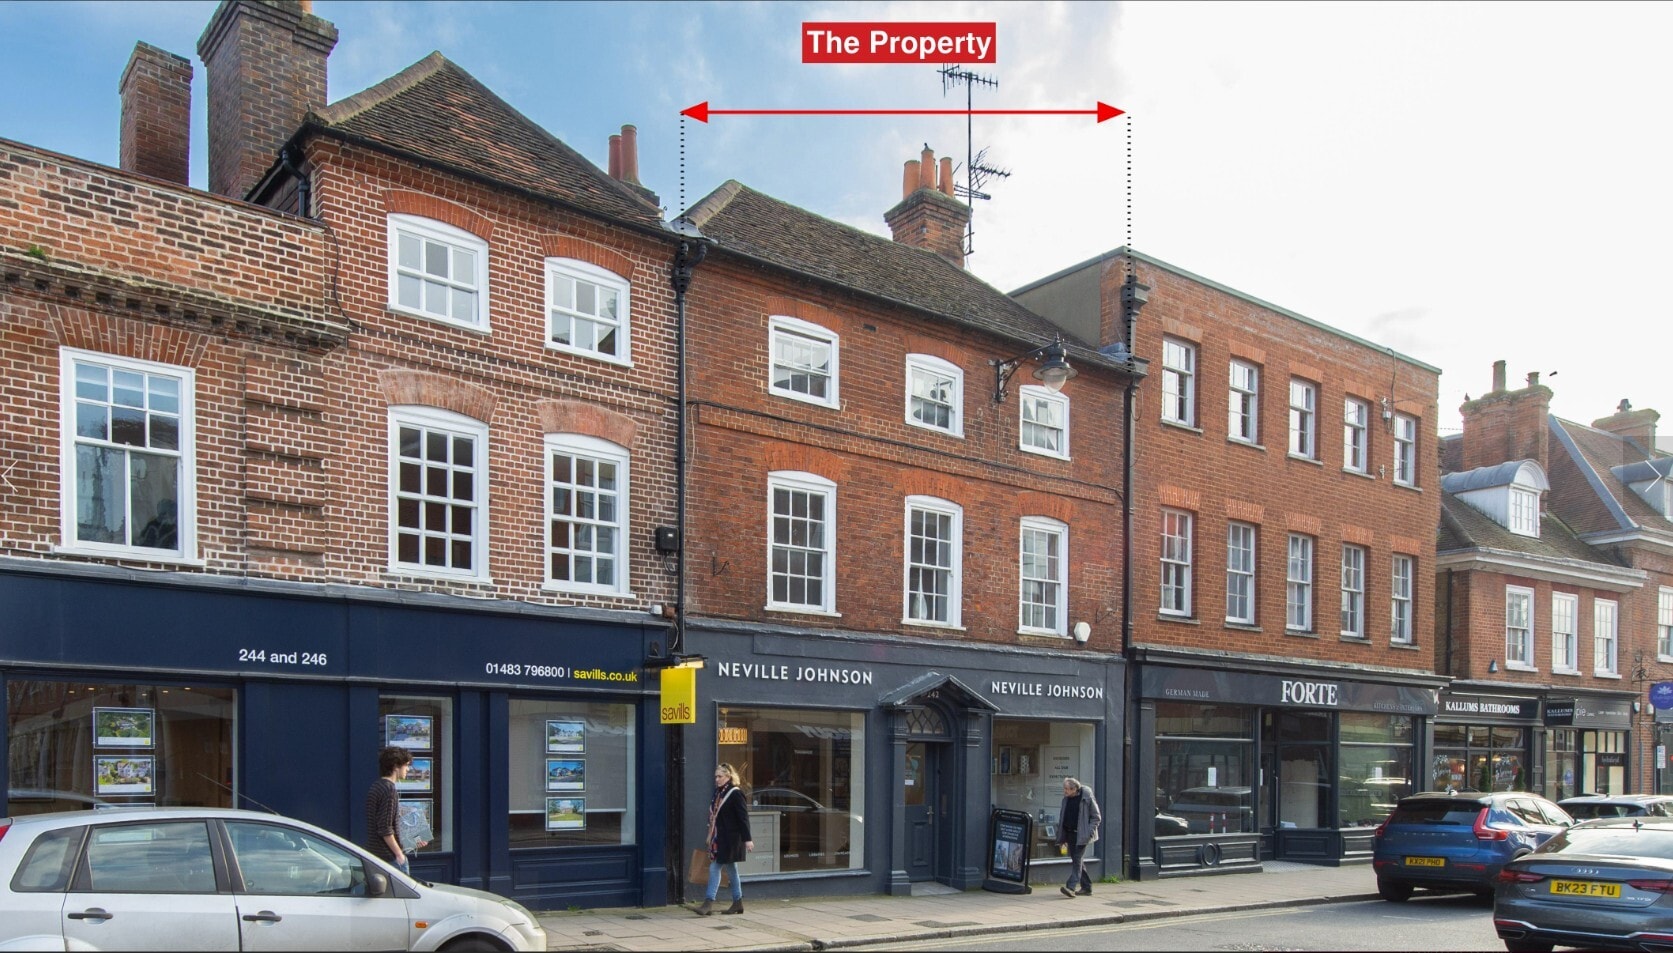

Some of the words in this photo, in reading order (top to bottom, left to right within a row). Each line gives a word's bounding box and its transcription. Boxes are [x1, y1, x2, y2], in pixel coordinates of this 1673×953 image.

[239, 648, 266, 662] 244
[270, 651, 298, 664] and
[301, 652, 327, 666] 246
[485, 662, 521, 676] 01483
[524, 664, 565, 678] 796800
[573, 668, 638, 682] savills.co.uk
[717, 661, 789, 681] NEVILLE
[796, 666, 873, 685] JOHNSON
[991, 681, 1043, 697] NEVILLE
[1047, 684, 1104, 699] JOHNSON
[1165, 688, 1192, 697] GERMAN
[1193, 690, 1210, 698] MADE
[1280, 680, 1338, 706] FORTE
[661, 702, 691, 721] savills
[1445, 701, 1479, 712] KALLUMS
[1479, 703, 1520, 714] BATHROOMS
[1556, 882, 1588, 894] BK23
